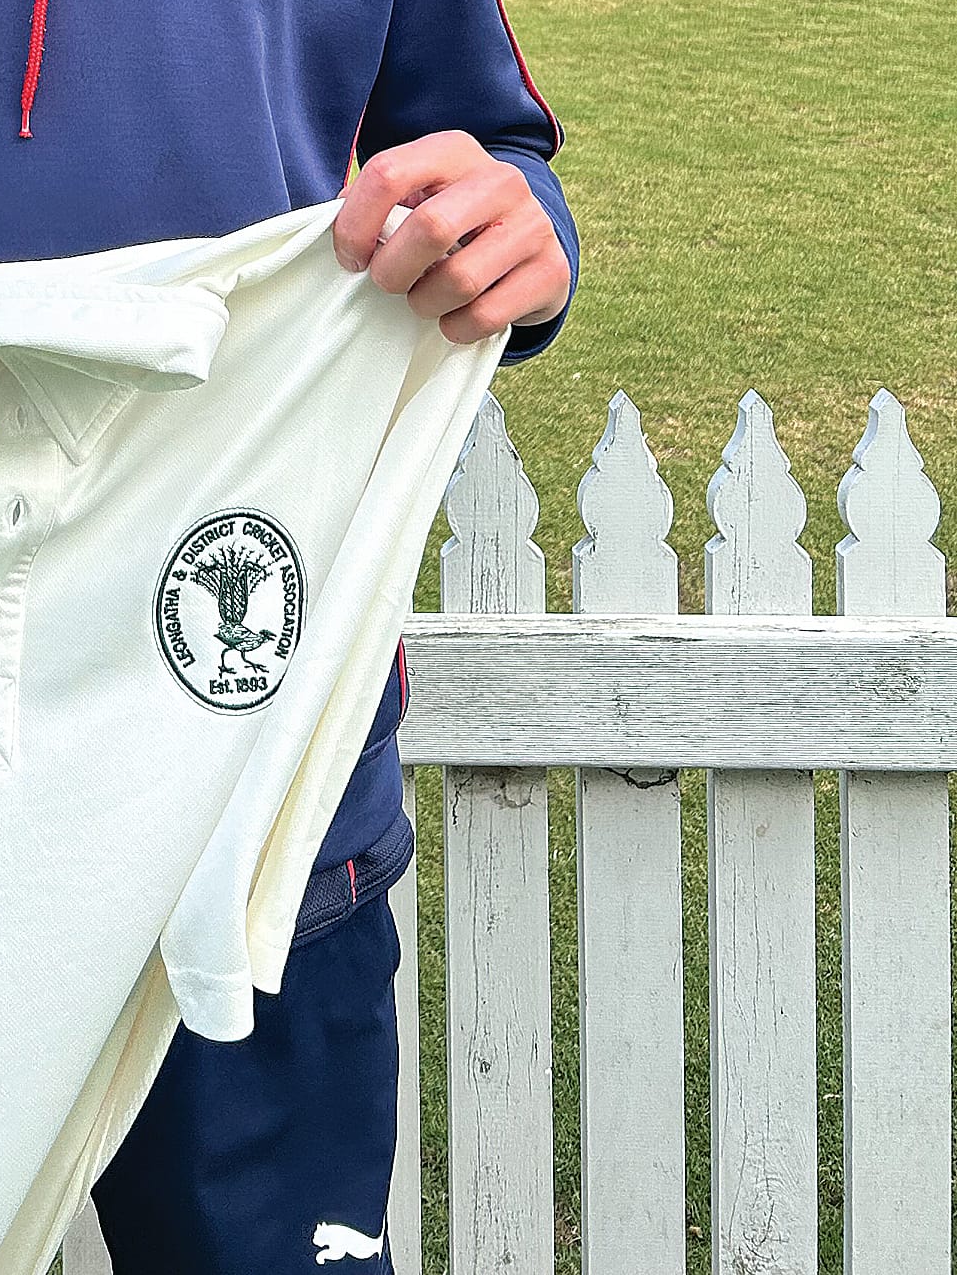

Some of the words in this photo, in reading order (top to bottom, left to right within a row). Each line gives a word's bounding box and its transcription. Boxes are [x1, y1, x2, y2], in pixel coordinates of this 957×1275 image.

[181, 521, 236, 565] DISTRICT
[242, 521, 288, 563] CRICKET
[172, 569, 187, 582] &
[164, 587, 196, 669] LEONGATHA
[274, 564, 297, 660] ASSOCIATION
